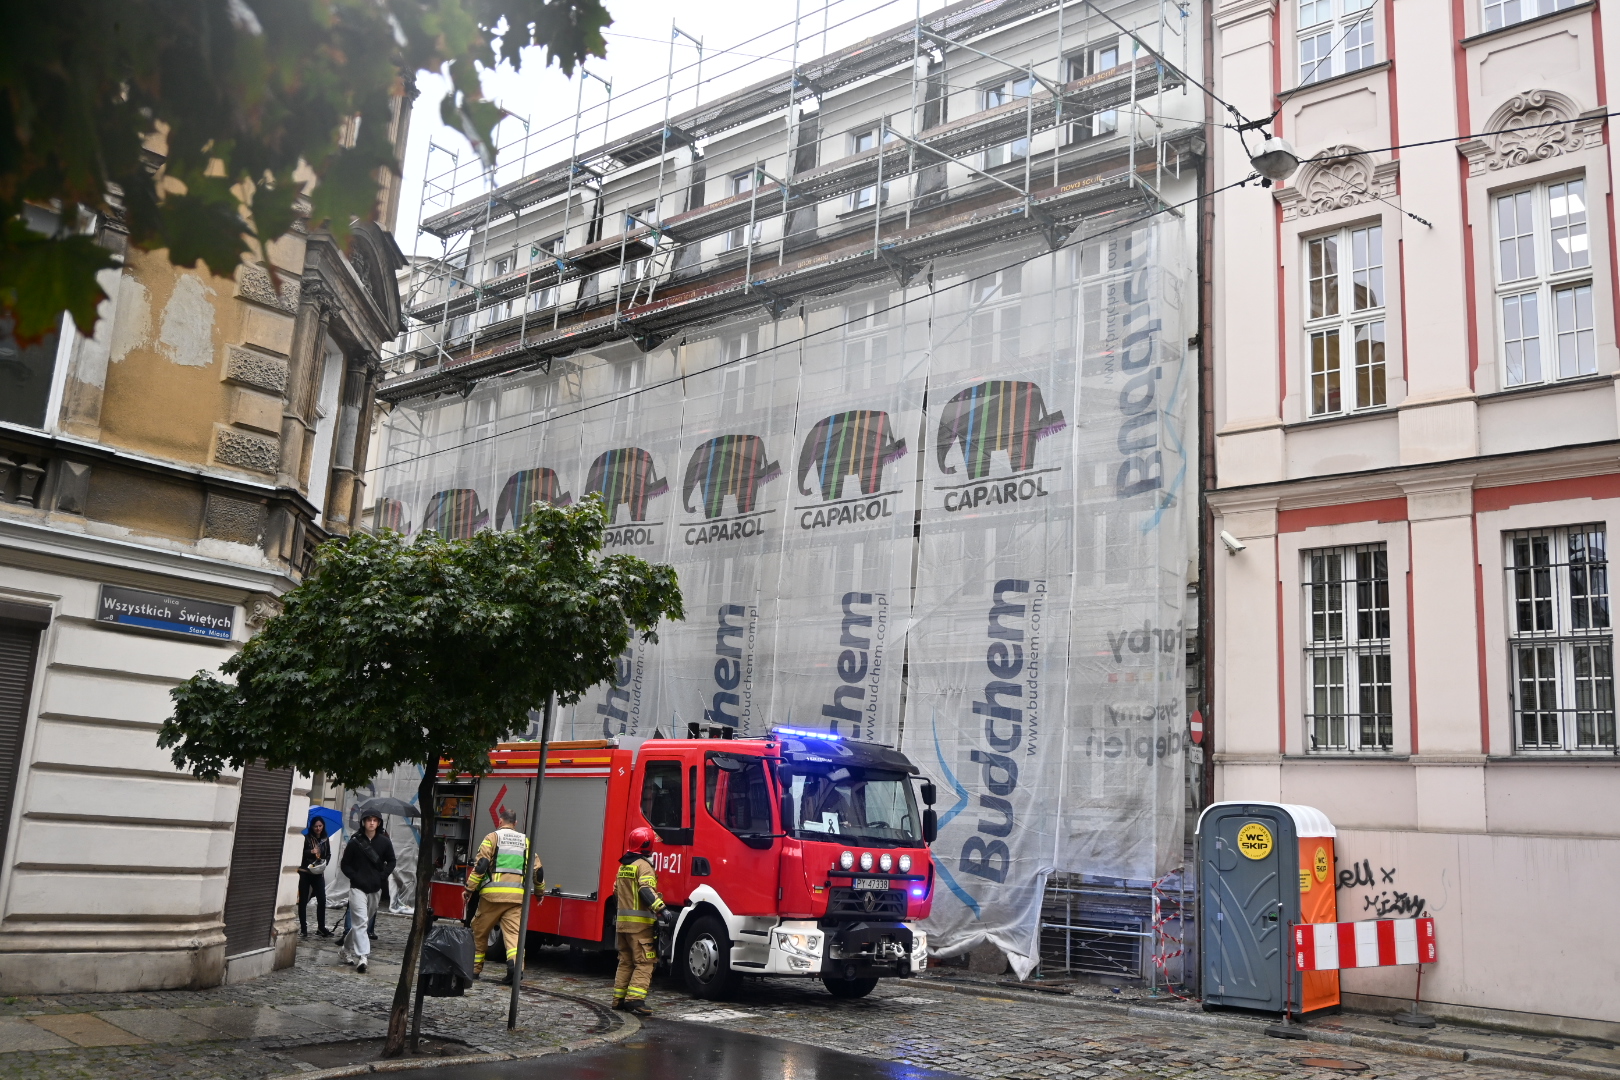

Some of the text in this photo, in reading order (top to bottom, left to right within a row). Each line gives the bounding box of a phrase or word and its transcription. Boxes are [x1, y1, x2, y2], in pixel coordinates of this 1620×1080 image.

[1060, 181, 1081, 192] nova
[944, 475, 1049, 513] CAPAROL
[800, 497, 893, 531] CAPAROL
[603, 528, 655, 549] PAROL
[684, 517, 766, 546] CAPAROL
[103, 597, 231, 629] Wszystkich Świętych
[163, 598, 180, 606] ulica
[188, 626, 230, 639] Stare Miasto
[742, 605, 758, 736] w.budchem.com.pl
[865, 592, 891, 743] ww.budchem.com.pl
[1026, 579, 1048, 757] www.budchem.com.pl
[958, 578, 1031, 885] Budchem
[1241, 842, 1268, 850] SKIP
[1245, 834, 1264, 842] WC
[1316, 865, 1327, 873] SKIP
[856, 879, 888, 889] PY 47338
